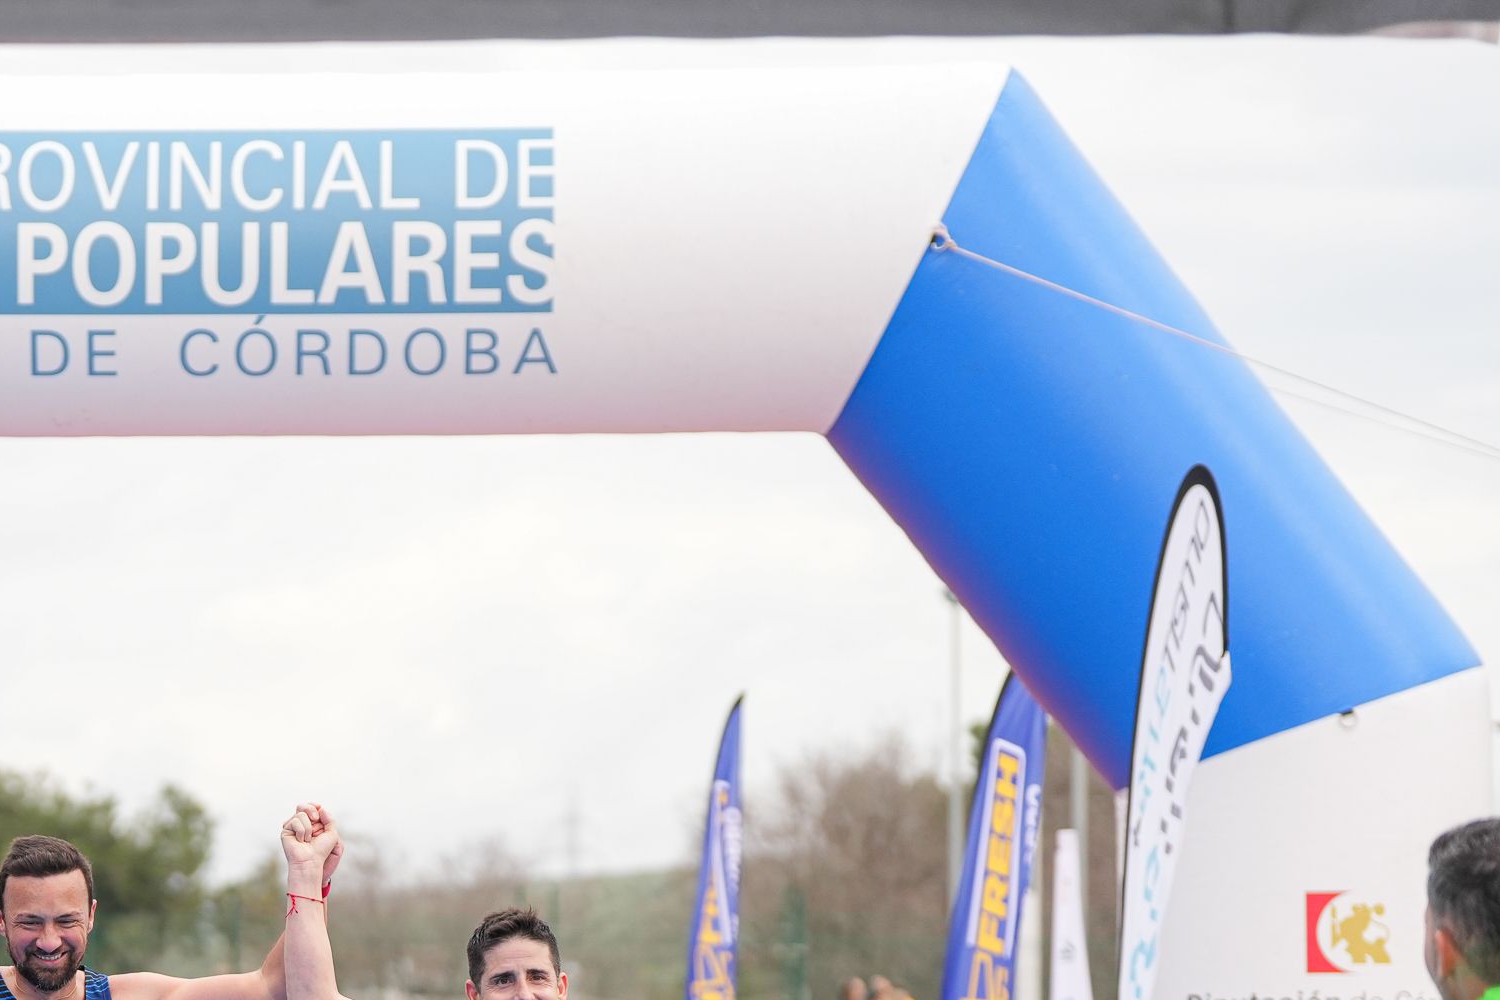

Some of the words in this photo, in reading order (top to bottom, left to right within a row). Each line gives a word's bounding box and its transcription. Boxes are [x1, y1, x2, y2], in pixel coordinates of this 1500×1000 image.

[454, 138, 555, 211] DE
[18, 217, 555, 306] POPULARES
[30, 327, 119, 377] DE
[180, 314, 559, 377] CÓRDOBA
[975, 750, 1021, 956] FRESH
